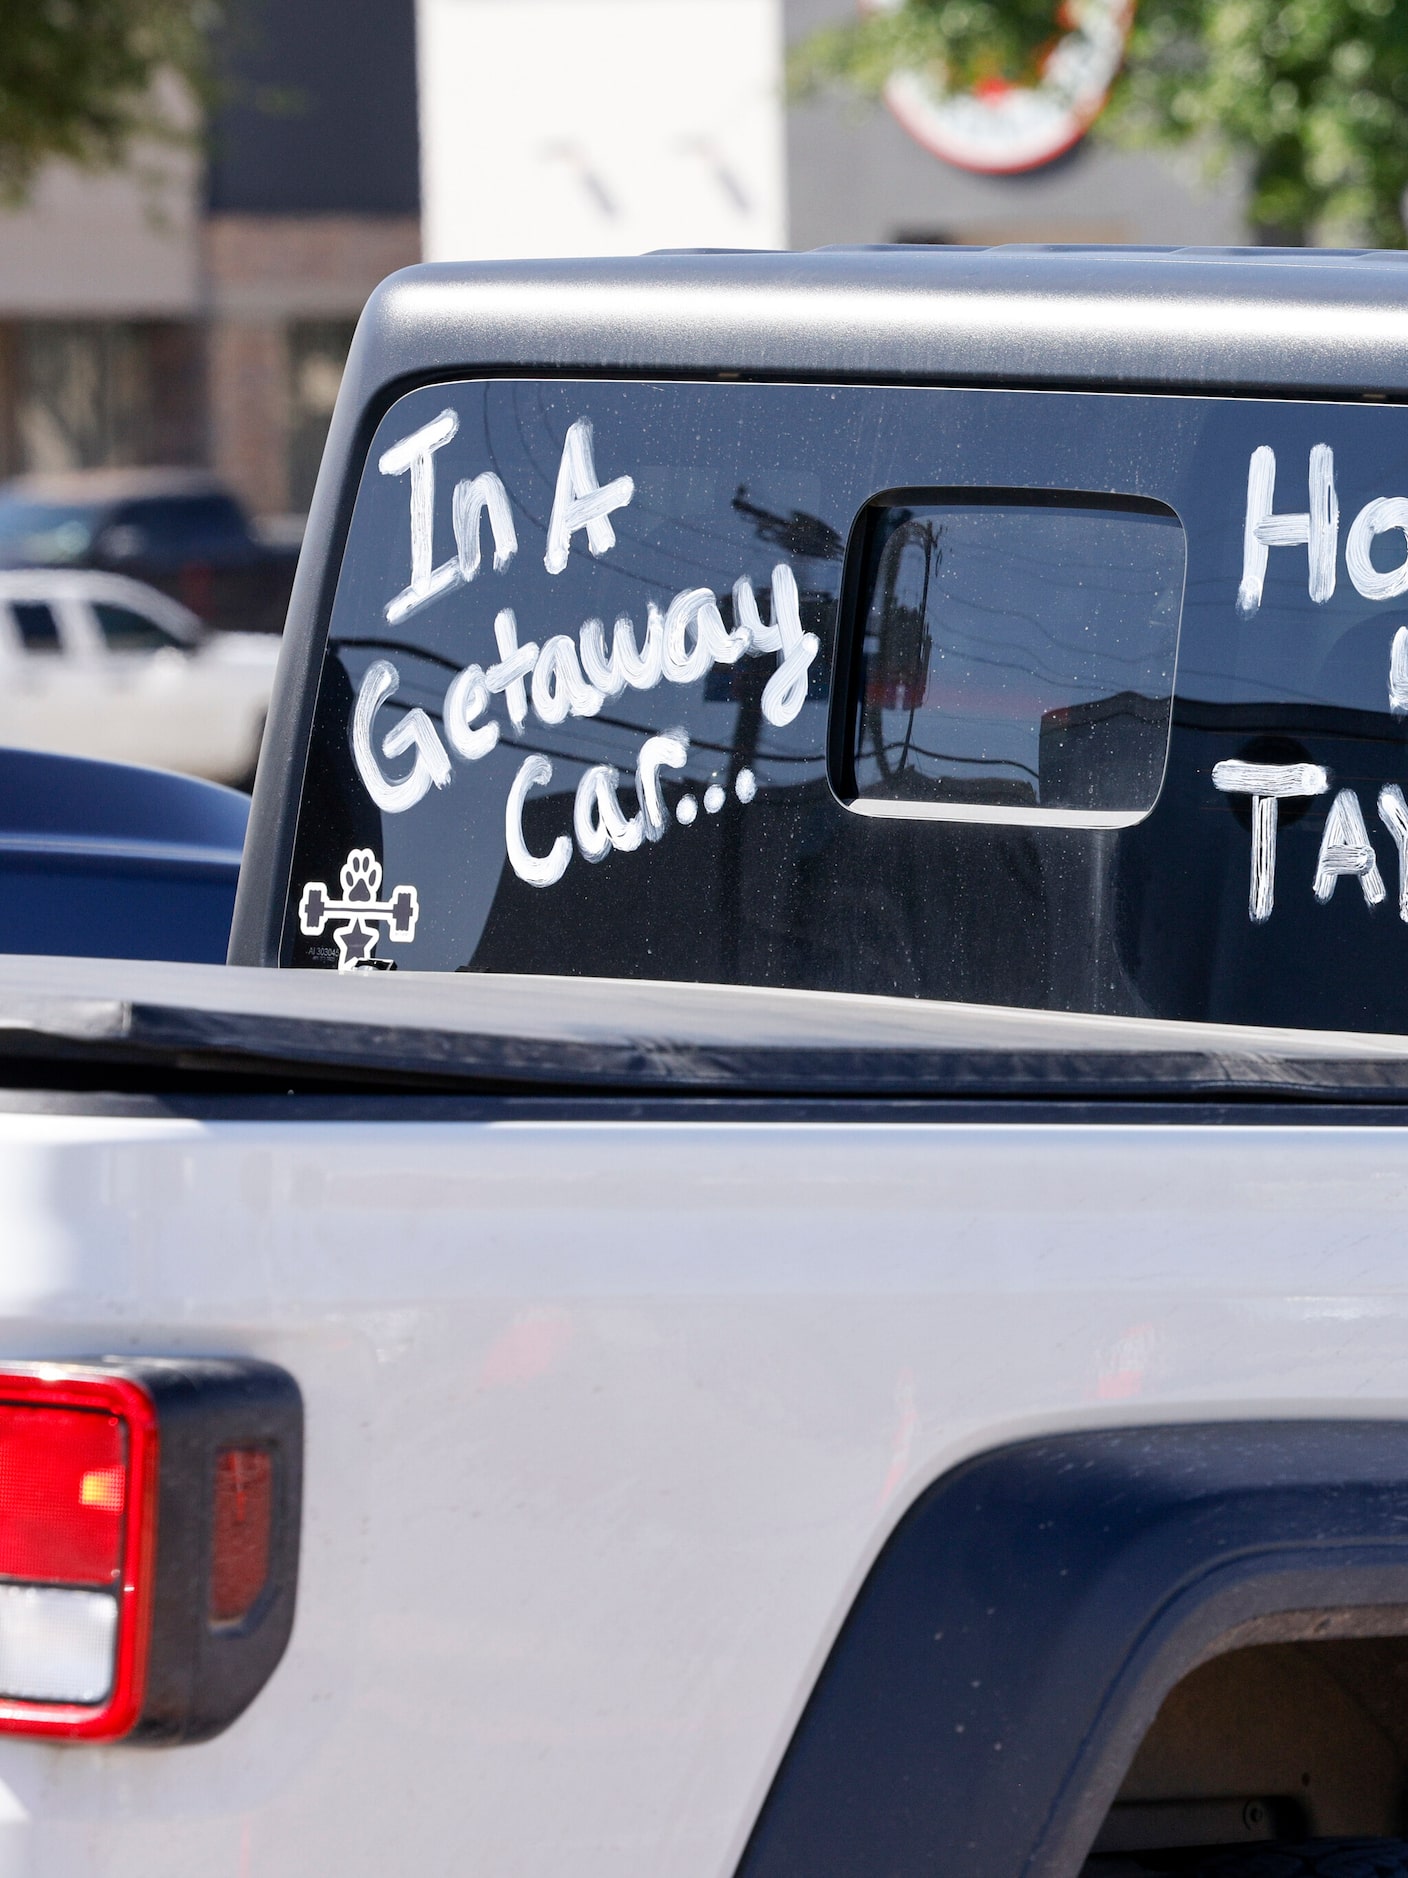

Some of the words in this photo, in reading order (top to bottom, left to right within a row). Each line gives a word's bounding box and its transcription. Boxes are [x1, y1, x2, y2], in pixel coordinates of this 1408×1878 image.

[379, 408, 517, 624] In
[544, 416, 634, 574] A
[350, 563, 819, 813] Getaway
